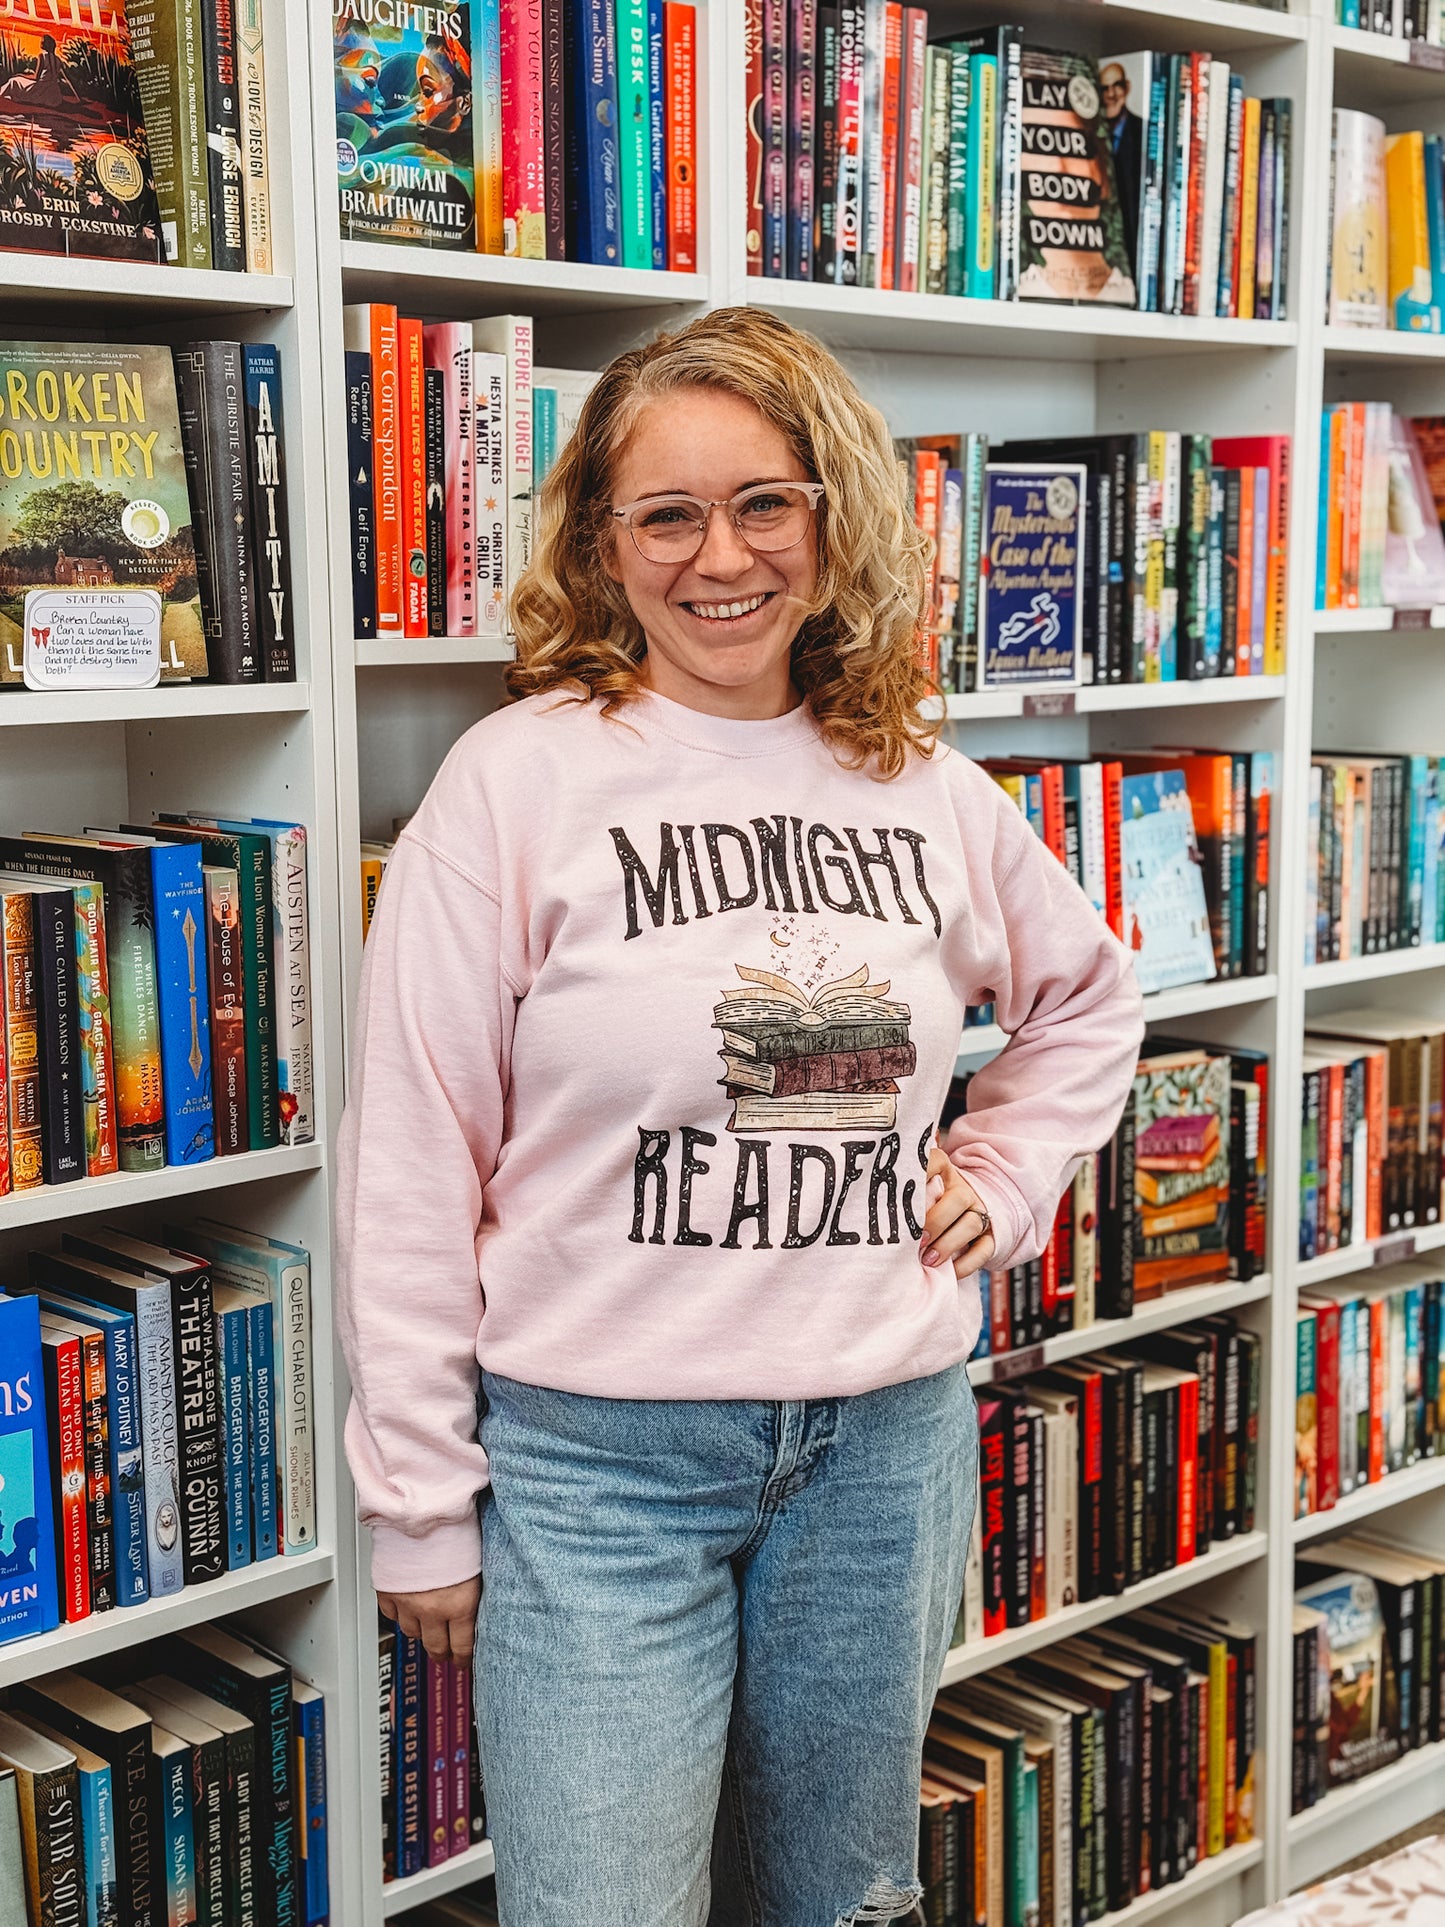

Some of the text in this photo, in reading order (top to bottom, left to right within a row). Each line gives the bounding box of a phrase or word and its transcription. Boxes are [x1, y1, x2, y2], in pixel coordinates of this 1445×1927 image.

[528, 30, 540, 82] YOUR
[591, 35, 607, 87] Sunny
[631, 27, 644, 84] DESK
[841, 10, 855, 82] BROWN
[682, 54, 691, 158] EXTRAORDINARY
[823, 69, 834, 107] KLINE
[1026, 82, 1067, 108] LAY
[248, 80, 263, 178] LOVE DESIGN
[1022, 126, 1087, 155] YOUR
[360, 160, 447, 193] OYINKAN
[527, 162, 536, 190] CHA
[635, 130, 645, 236] LAURA DICKERMAN
[842, 155, 858, 185] BE
[1028, 173, 1091, 202] BODY
[43, 197, 80, 214] ERIN
[61, 216, 137, 238] ECKSTINE
[190, 190, 200, 234] BOSTWICK
[224, 185, 241, 249] ERDRICH
[341, 189, 466, 227] BRAITHWAITE
[842, 199, 858, 252] YOU
[1030, 220, 1103, 248] DOWN
[0, 370, 146, 423] ROKEN
[350, 386, 360, 424] Refuse
[360, 381, 371, 442] Cheerfully
[376, 322, 399, 522] The Correspondent
[515, 326, 532, 476] BEFORE FORGET
[0, 429, 159, 480] OUNTRY
[223, 353, 243, 502] THE CHRISTIE AFFAIR
[409, 334, 423, 548] THE THREE LIVES CATE KAY
[476, 419, 489, 465] MATCH
[490, 376, 502, 485] HESTIA STRIKES
[356, 507, 369, 575] Leif Enger
[462, 460, 471, 602] SIERRA GREER
[477, 536, 490, 579] GRILLO
[492, 522, 503, 589] CHRISTINE
[990, 534, 1076, 567] Case of the
[237, 535, 251, 648] NINA GRAMONT
[391, 543, 399, 594] VIRGINIA
[66, 595, 125, 604] STAFF PICK
[90, 611, 130, 628] Country
[410, 582, 419, 623] FAGAN
[51, 636, 152, 646] two loves with
[56, 625, 144, 636] Can woman have
[80, 655, 138, 668] destroy them
[608, 815, 941, 940] MIDNIGHT
[87, 903, 101, 999] GOOD HAIR DAYS
[219, 881, 235, 1018] The House Eve
[253, 850, 268, 1007] The Lion Women Tehran
[287, 862, 306, 1029] AUSTEN SEA
[12, 956, 21, 977] Lost
[24, 971, 34, 995] Book
[54, 921, 69, 1065] GIRL CALLED SAMSON
[133, 945, 147, 1041] FIREFLIES DANCE
[93, 1011, 108, 1130] GRACE HELENA WALZ
[140, 1063, 151, 1106] HASSAN
[151, 1067, 159, 1100] AISHA
[261, 1043, 271, 1138] MARJAN KAMALI
[290, 1047, 302, 1094] JENNER
[303, 1043, 311, 1095] NATALIE
[26, 1082, 35, 1123] KRISTIN
[227, 1056, 239, 1147] Sadeqa Johnson
[180, 1298, 204, 1430] THEATRE
[201, 1295, 217, 1425] The WHALEBONE
[289, 1277, 306, 1436] QUEEN CHARLOTTE
[60, 1353, 73, 1462] VIVIAN STONE
[72, 1376, 83, 1458] ONE ONLY
[114, 1330, 132, 1446] MARY JO PUTNEY
[159, 1336, 176, 1471] AMANDA QUICK
[257, 1367, 269, 1457] BRIDGERTON
[231, 1375, 243, 1466] BRIDGERTON
[92, 1397, 106, 1524] LIGHT THIS WORLD
[186, 1453, 218, 1468] KNOPF
[290, 1445, 299, 1483] SHONDA
[980, 1432, 1004, 1483] HOT
[185, 1479, 208, 1556] QUINN
[207, 1476, 220, 1551] JOANNA
[234, 1492, 243, 1517] DUKE
[262, 1482, 270, 1507] DUKE
[71, 1504, 83, 1613] MELISSA O'CONNOR
[271, 1714, 291, 1794] Listeners
[405, 1663, 418, 1843] DELE WEDS DESTINY
[171, 1765, 184, 1818] MECCA
[48, 1800, 75, 1864] STAR
[128, 1795, 152, 1911] SCHWAB
[173, 1834, 188, 1885] SUSAN
[207, 1781, 223, 1900] LADY CIRCLE
[237, 1772, 252, 1890] LADY CIRCLE
